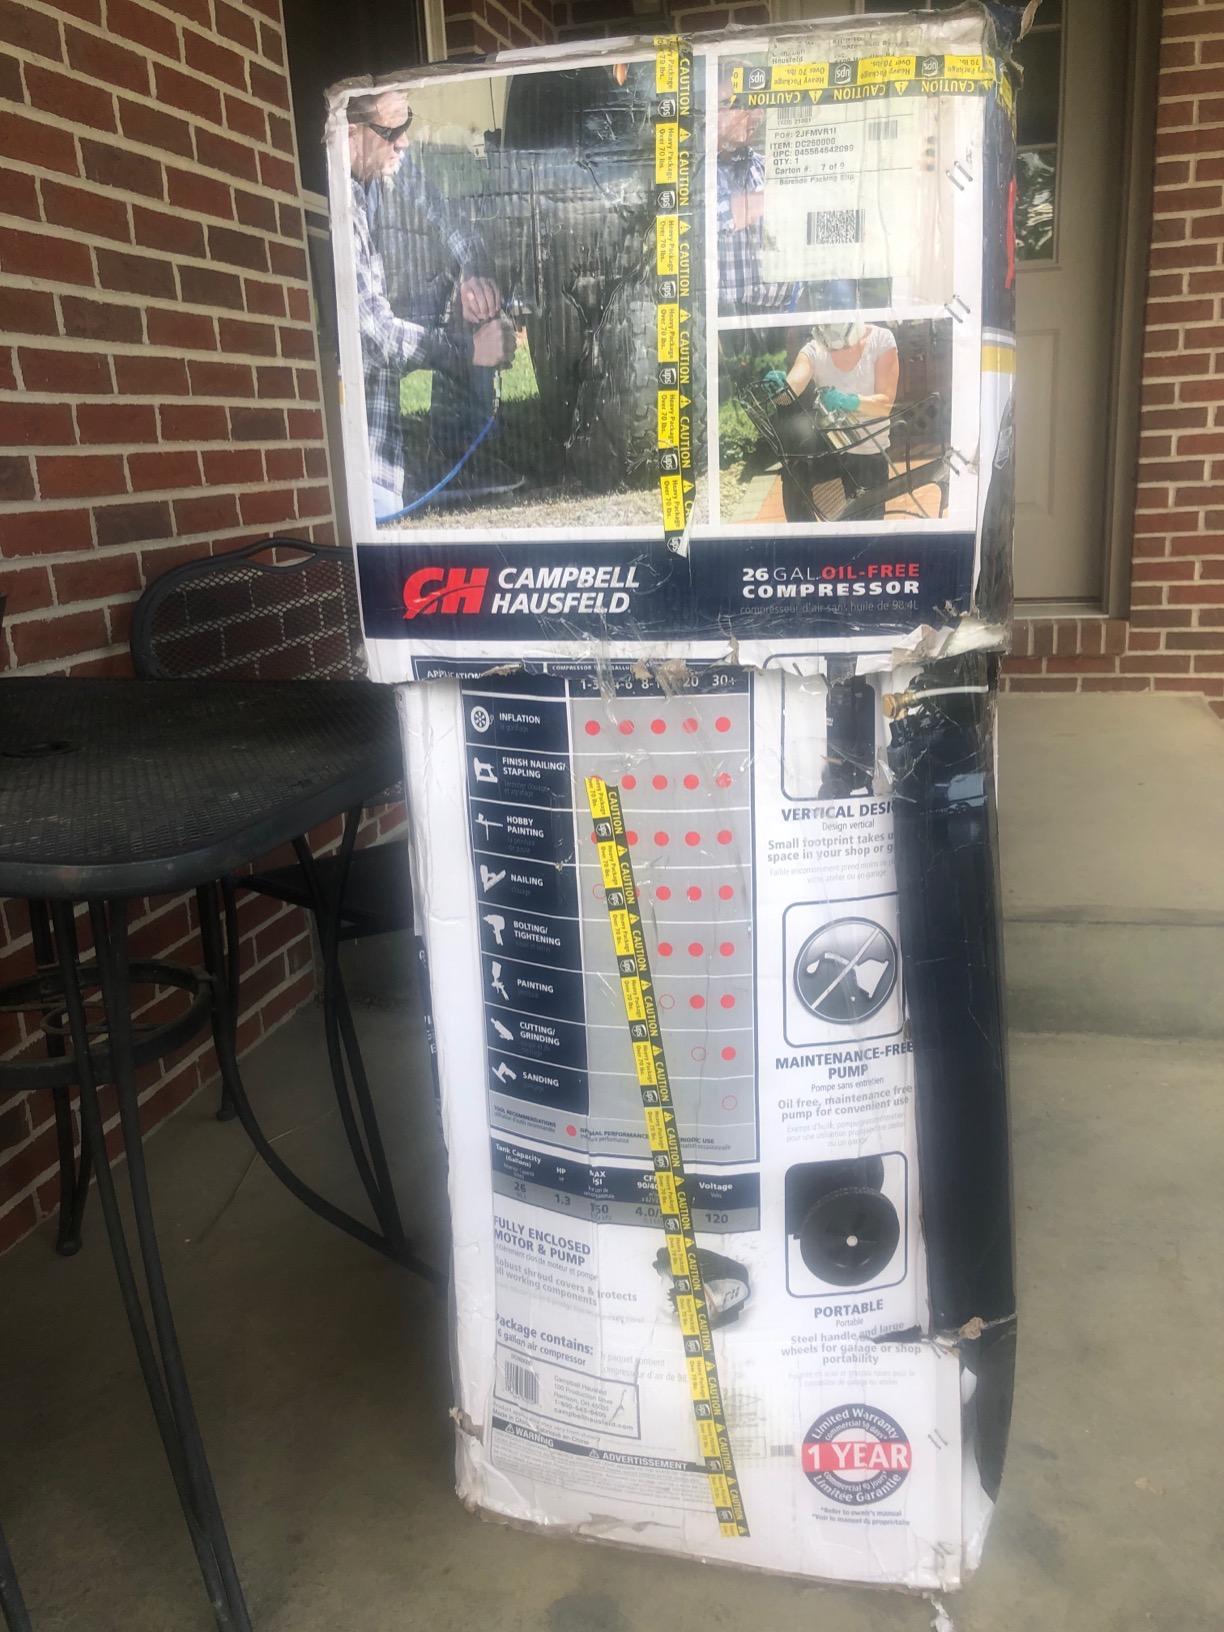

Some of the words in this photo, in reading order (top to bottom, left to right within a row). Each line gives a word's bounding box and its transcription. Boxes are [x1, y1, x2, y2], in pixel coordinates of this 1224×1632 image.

[679, 58, 690, 116] CAUTION
[747, 92, 801, 105] CAUTION
[833, 83, 886, 100] CAUTION
[921, 79, 974, 93] CAUTION
[659, 148, 665, 157] 70
[769, 141, 792, 150] ITEM:
[773, 150, 792, 158] UPC:
[773, 158, 793, 166] QTY:
[829, 162, 837, 170] of
[679, 151, 690, 206] CAUTION
[679, 243, 690, 297] CAUTION
[662, 281, 672, 298] ups
[679, 331, 690, 384] CAUTION
[663, 368, 673, 385] ups
[680, 416, 691, 469] CAUTION
[664, 454, 674, 470] ups
[498, 566, 640, 589] CAMPBELL
[742, 567, 769, 581] 26
[822, 563, 920, 580] OIL-FREE
[742, 580, 920, 598] COMPRESSOR
[491, 592, 630, 614] HAUSFELD
[877, 601, 888, 610] de
[711, 674, 736, 687] 30+
[499, 712, 541, 725] INFLATION
[502, 756, 529, 767] FINISH
[503, 767, 541, 779] STAPLING
[506, 815, 534, 827] HOBBY
[781, 804, 855, 822] VERTICAL
[507, 826, 545, 839] PAINTING
[822, 821, 848, 831] Design
[849, 819, 875, 830] vertical
[768, 838, 799, 850] Small
[802, 835, 854, 851] footprint
[857, 831, 885, 844] takes
[767, 852, 799, 864] space
[802, 851, 813, 859] in
[816, 849, 842, 861] your
[844, 846, 871, 858] shop
[873, 844, 884, 853] or
[510, 873, 544, 887] NAILING
[514, 930, 561, 946] TIGHTENING
[517, 978, 554, 993] PAINTING
[520, 1031, 561, 1046] GRINDING
[775, 1041, 914, 1070] MAINTENANCE-FREE
[522, 1071, 560, 1087] SANDING
[828, 1064, 869, 1080] PUMP
[811, 1082, 836, 1093] Pompe
[837, 1081, 853, 1090] sans
[777, 1099, 793, 1110] Oil
[824, 1088, 891, 1106] maintenance
[893, 1084, 913, 1096] free
[781, 1109, 813, 1122] pump
[816, 1107, 833, 1117] for
[834, 1098, 891, 1115] convenient
[608, 790, 624, 835] CAUTION
[620, 861, 636, 905] CAUTION
[632, 929, 647, 972] CAUTION
[644, 995, 658, 1037] CAUTION
[655, 1061, 670, 1102] CAUTION
[666, 1127, 681, 1168] CAUTION
[677, 1191, 691, 1230] CAUTION
[688, 1252, 702, 1291] CAUTION
[698, 1313, 712, 1351] CAUTION
[708, 1376, 721, 1416] CAUTION
[718, 1436, 733, 1471] CAUTION
[496, 1144, 511, 1154] Tank
[512, 1149, 542, 1165] Capacity
[556, 1166, 566, 1174] HP
[698, 1181, 734, 1191] Voltage
[554, 1194, 571, 1206] 1.3
[704, 1213, 729, 1224] 120
[493, 1215, 525, 1235] FULLY
[528, 1226, 592, 1255] ENCLOSED
[493, 1228, 534, 1251] MOTOR
[536, 1243, 547, 1256] &
[550, 1246, 586, 1267] PUMP
[523, 1264, 554, 1284] shroud
[555, 1278, 585, 1293] covers
[506, 1270, 541, 1291] working
[542, 1282, 598, 1306] components
[813, 1299, 884, 1319] PORTABLE
[835, 1318, 864, 1328] Portable
[540, 1330, 594, 1356] contains:
[790, 1333, 818, 1345] Steel
[820, 1331, 856, 1343] handle
[502, 1332, 526, 1349] gallon
[527, 1340, 537, 1351] air
[540, 1345, 586, 1366] compressor
[781, 1343, 818, 1357] wheels
[821, 1343, 837, 1353] for
[880, 1344, 892, 1353] or
[895, 1343, 922, 1356] shop
[822, 1354, 880, 1366] portability
[811, 1409, 850, 1440] Limited
[852, 1407, 900, 1440] Warranty
[602, 1451, 688, 1470] ADVERTISSEMENT
[807, 1443, 820, 1469] 1
[831, 1442, 910, 1469] YEAR
[855, 1473, 903, 1502] Garantie
